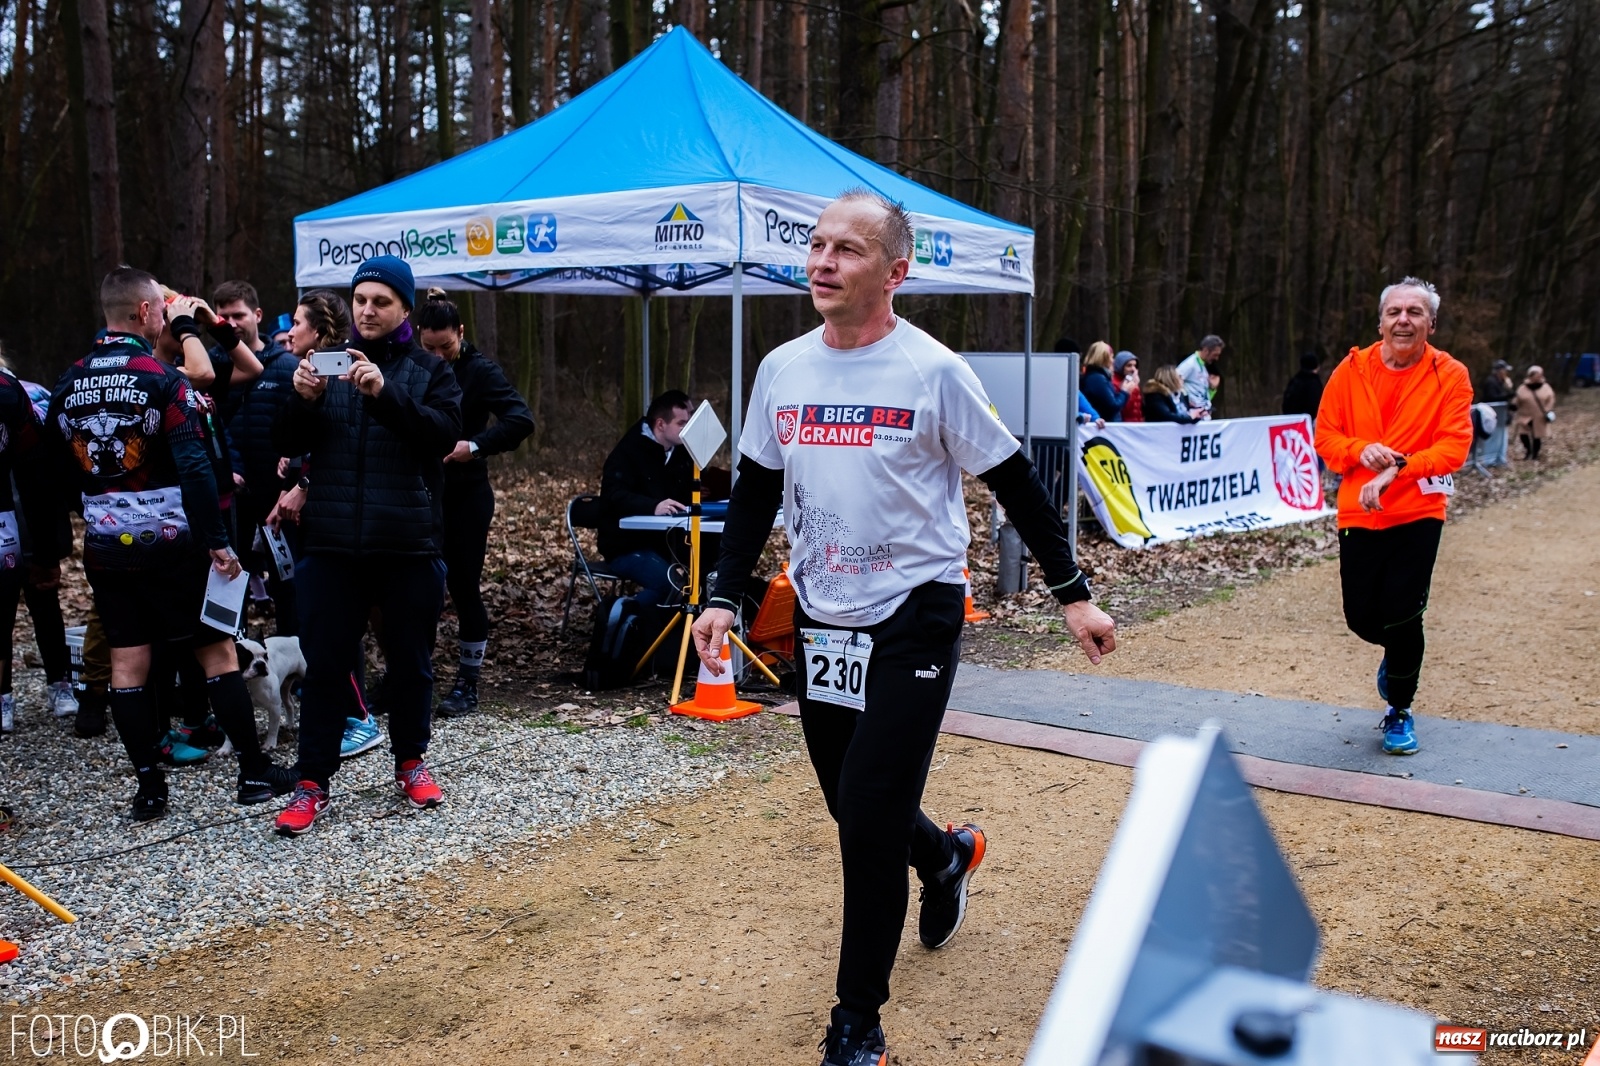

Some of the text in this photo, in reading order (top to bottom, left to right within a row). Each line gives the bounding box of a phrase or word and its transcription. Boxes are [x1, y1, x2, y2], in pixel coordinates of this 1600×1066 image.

[655, 223, 704, 243] MITKO
[318, 228, 458, 266] PersonalBest
[655, 243, 703, 251] for events
[64, 387, 149, 410] CROSS GAMES
[804, 406, 911, 428] X BIEG BEZ
[800, 426, 873, 445] GRANIC
[873, 433, 912, 444] 03.05.2017
[1180, 432, 1222, 464] BIEG
[1146, 469, 1261, 513] TWARDZIELA
[840, 543, 893, 557] 800 LAT
[840, 556, 858, 564] PRAW
[811, 654, 863, 695] 230
[915, 669, 938, 679] PUMA
